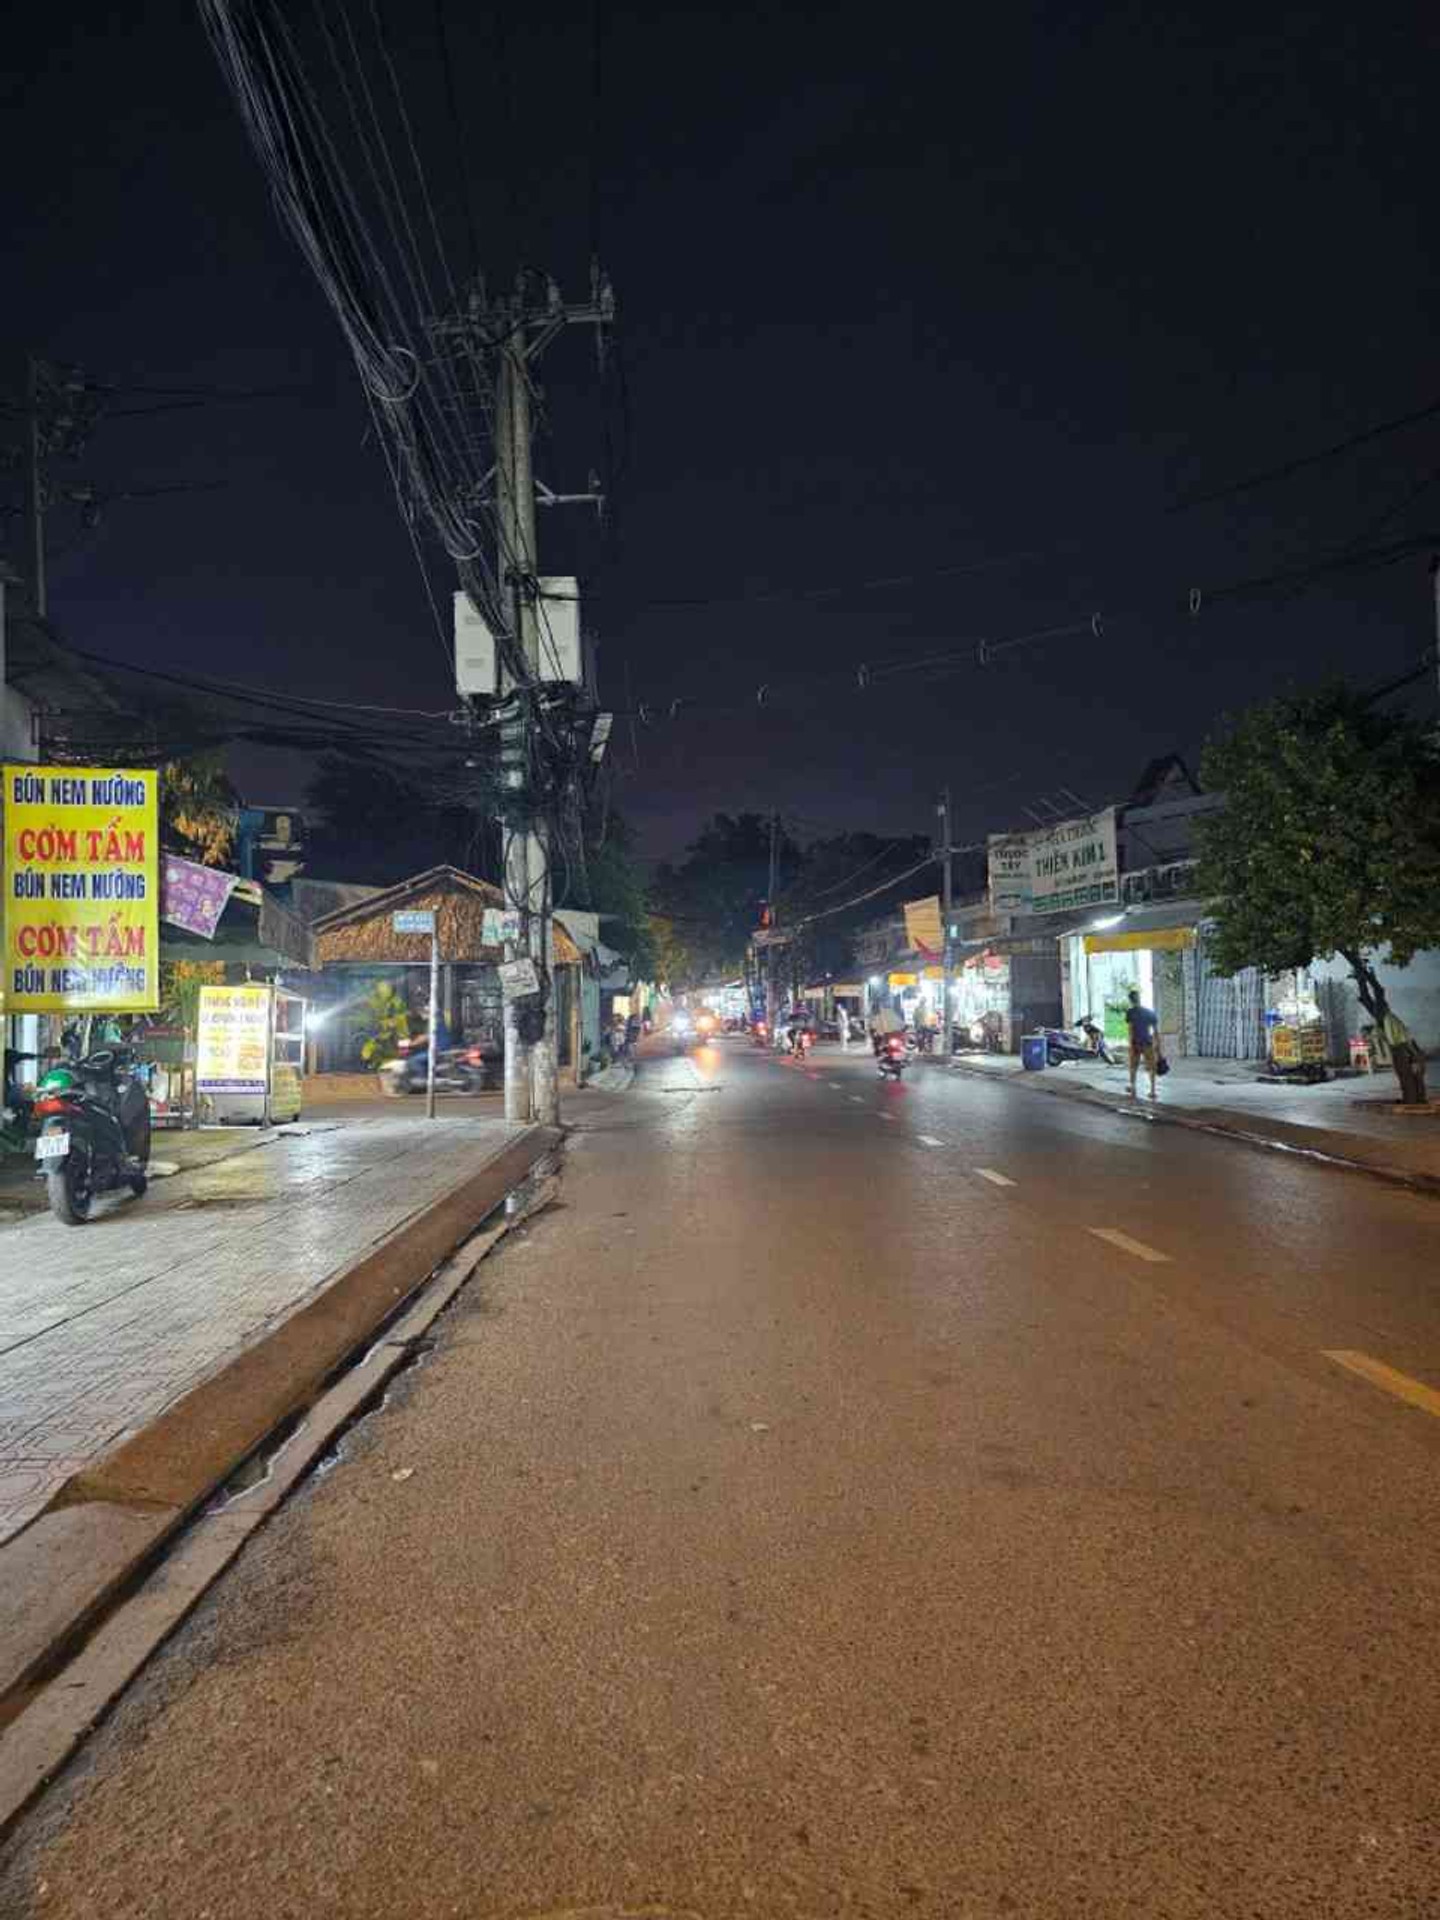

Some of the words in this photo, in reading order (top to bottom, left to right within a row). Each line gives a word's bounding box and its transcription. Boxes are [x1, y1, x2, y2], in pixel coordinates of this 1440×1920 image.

[14, 772, 45, 803] BÚN
[50, 778, 86, 805] NEM
[18, 823, 77, 861] CƠM
[86, 816, 145, 861] TẤM
[14, 867, 45, 898] BÚN
[50, 873, 86, 899] NEM
[18, 920, 77, 958] CƠM
[86, 912, 145, 958] TẤM
[14, 962, 45, 993] BÚN
